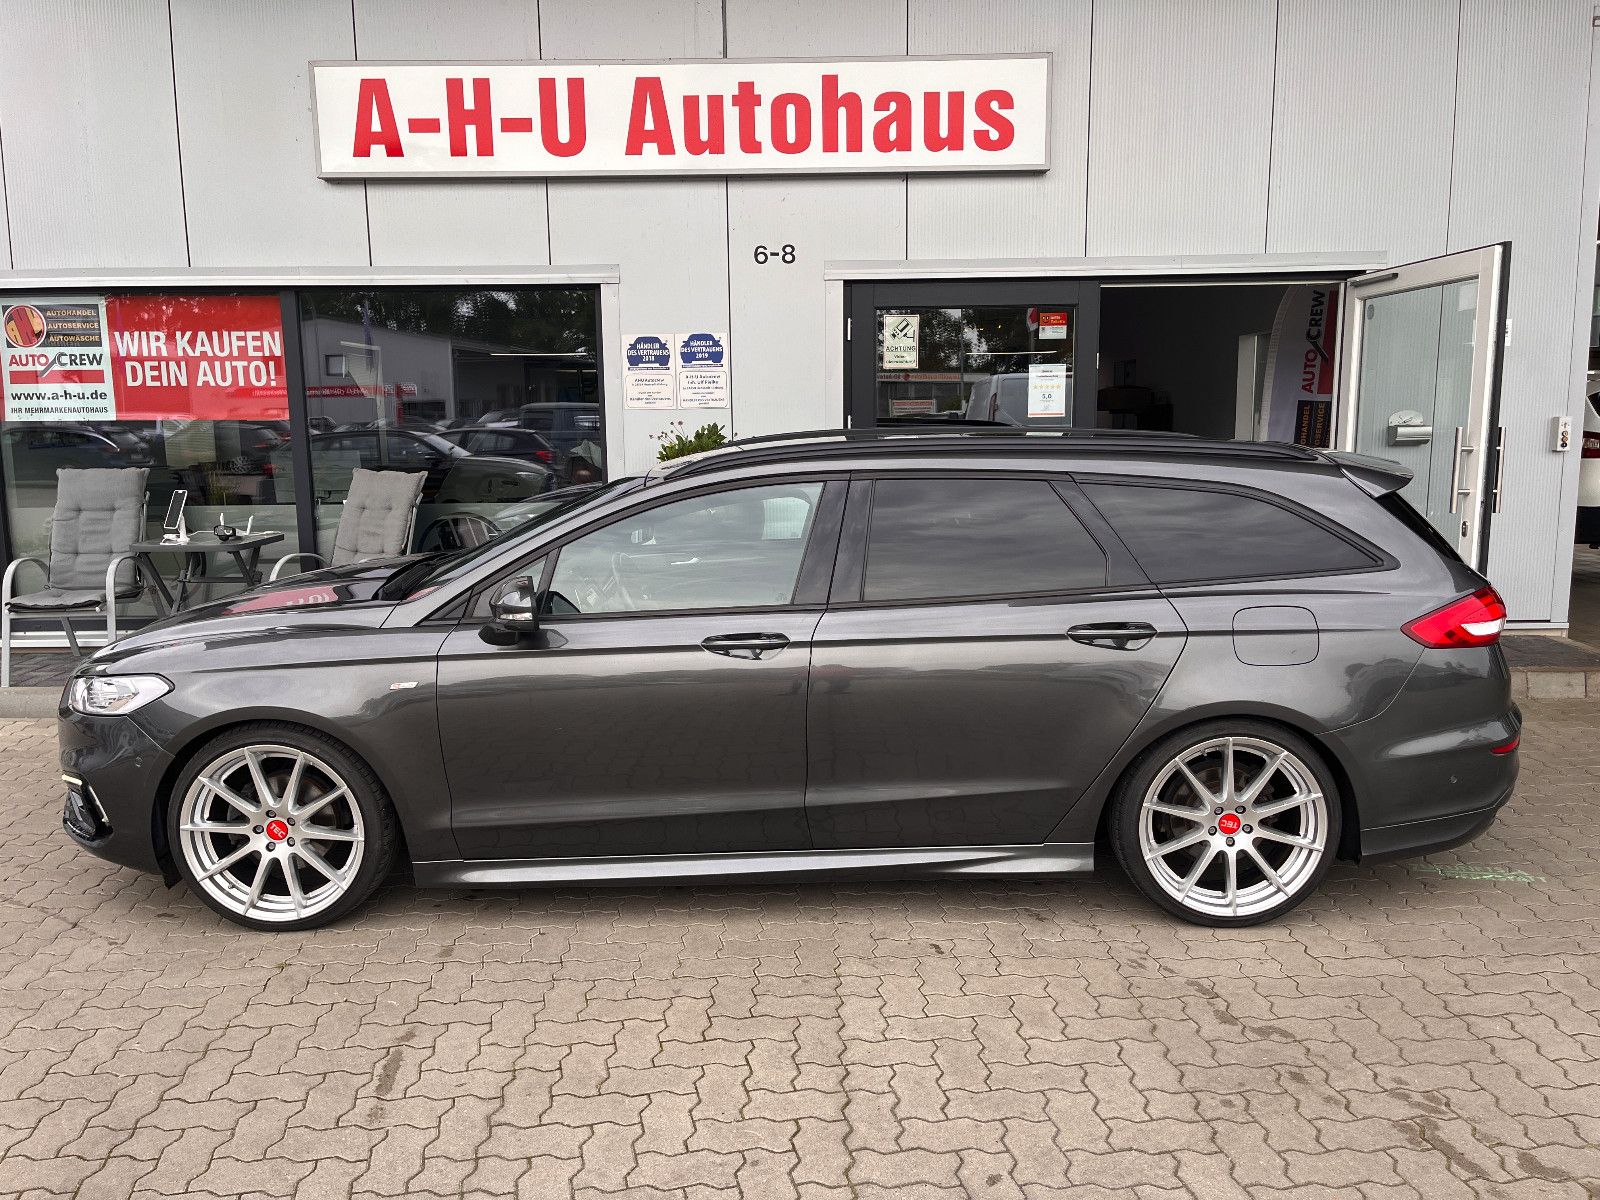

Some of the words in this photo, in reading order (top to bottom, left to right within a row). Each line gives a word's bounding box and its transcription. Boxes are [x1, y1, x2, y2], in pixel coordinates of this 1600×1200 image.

[352, 77, 587, 158] A-H-U
[624, 74, 1016, 157] Autohaus
[753, 243, 796, 265] 6-8
[1305, 289, 1326, 341] CREW
[114, 331, 167, 357] WIR
[175, 331, 282, 357] KAUFEN
[8, 353, 50, 367] AUTO
[57, 352, 104, 367] CREW
[1301, 349, 1318, 394] AUTO
[125, 361, 189, 387] DEIN
[197, 361, 277, 387] AUTO!
[11, 389, 108, 401] www.a-h-u.de
[24, 406, 109, 414] MEHRMARKENAUTOHAUS
[1300, 405, 1310, 446] OHANDEL
[1314, 402, 1326, 446] OSERVICE
[270, 822, 286, 839] TEC
[1221, 819, 1238, 829] TEC
